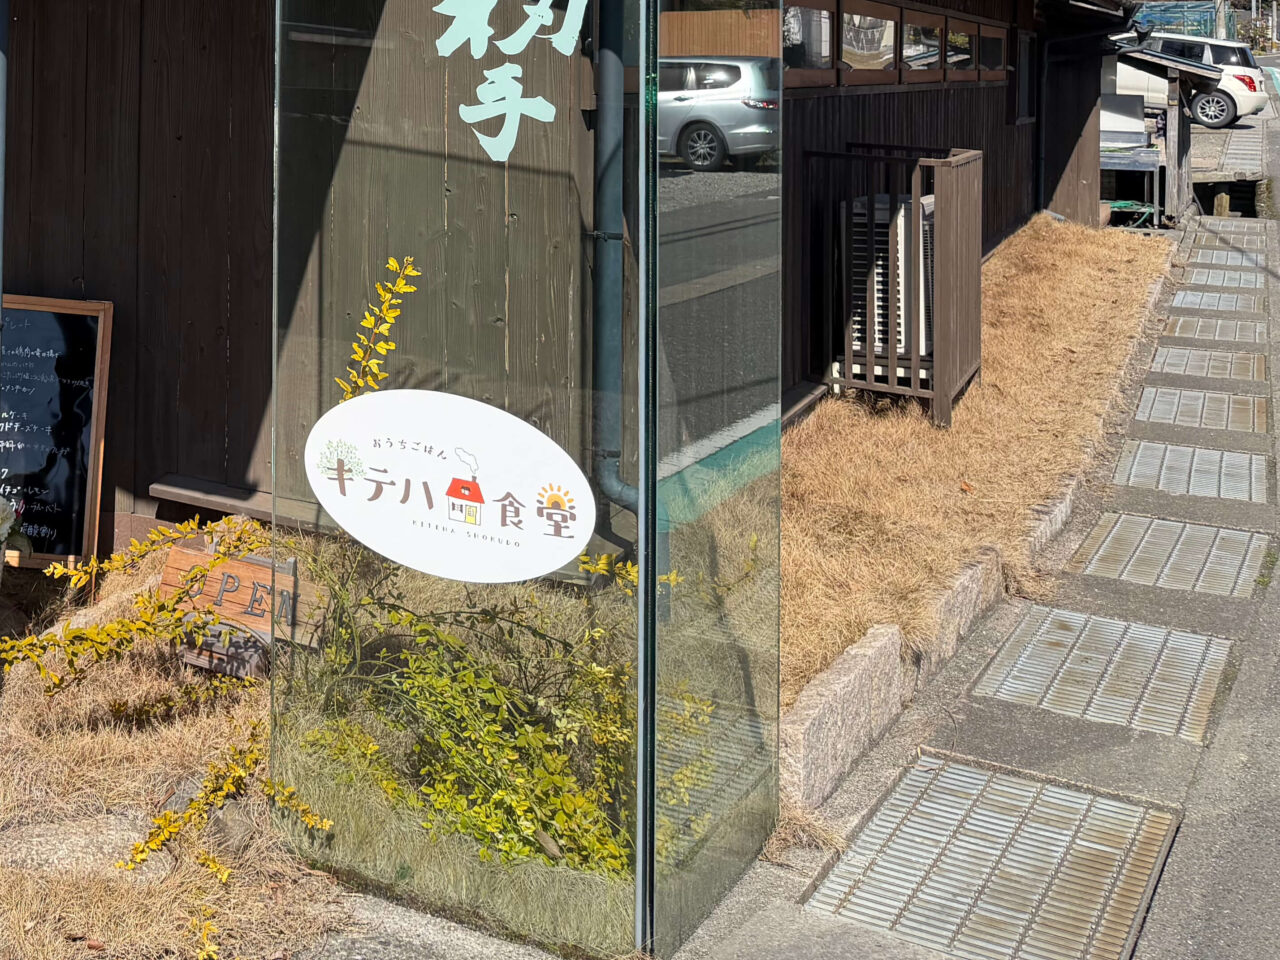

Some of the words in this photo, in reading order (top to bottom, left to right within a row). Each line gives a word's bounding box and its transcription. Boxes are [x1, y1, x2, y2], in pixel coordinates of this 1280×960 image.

[372, 437, 447, 460] おうちごはん
[184, 564, 300, 627] OPEN
